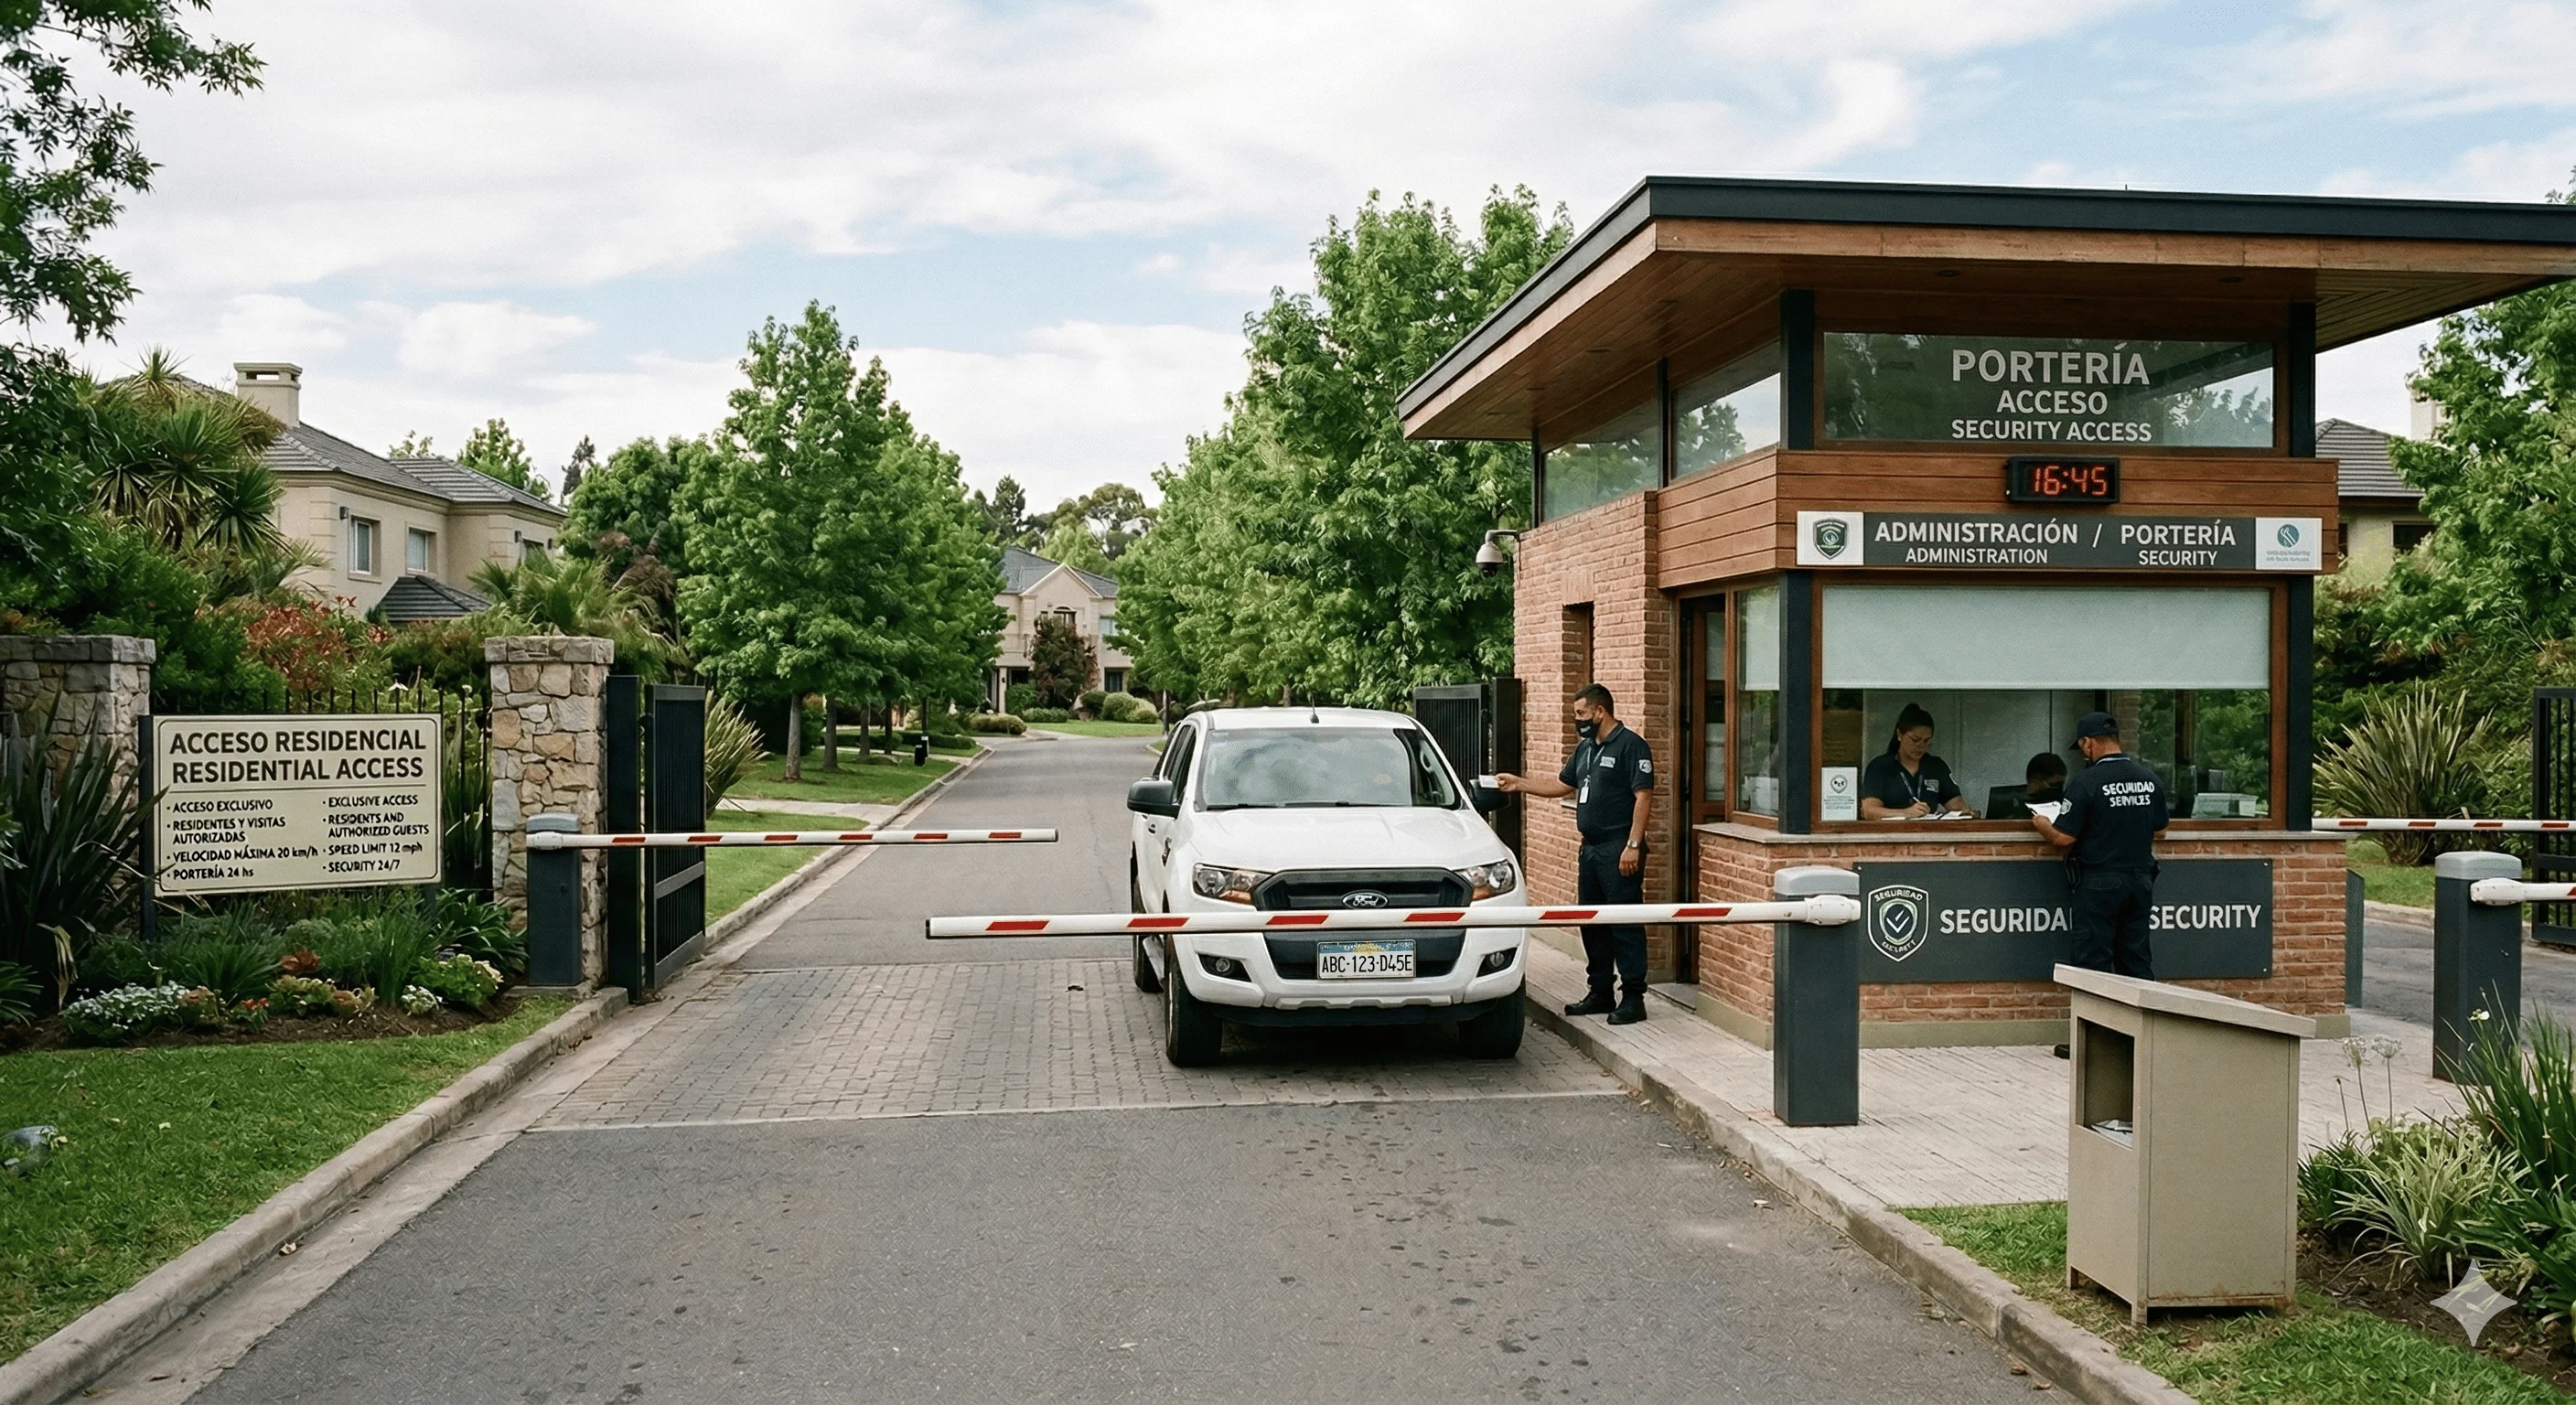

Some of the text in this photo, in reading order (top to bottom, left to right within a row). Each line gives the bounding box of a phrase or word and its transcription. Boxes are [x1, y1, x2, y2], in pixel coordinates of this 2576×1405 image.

[1951, 341, 2151, 385] PORTERÍA
[1996, 389, 2109, 415] ACCESO
[1951, 419, 2152, 442] SECURITY ACCESS
[2034, 465, 2107, 496] 16:45
[1874, 518, 2078, 544] ADMINISTRACIÓN
[2120, 519, 2237, 546] PORTERÍA
[1905, 547, 2048, 564] ADMINISTRATION
[2138, 550, 2218, 566] SECURITY
[169, 729, 426, 755] ACCESO RESIDENCIAL
[172, 756, 424, 784] RESIDENTIAL ACCESS
[172, 799, 274, 813] ACCESO EXCLUSIVO
[328, 795, 419, 808] EXCLUSIVE ACCESS
[172, 816, 286, 831] RESIDENTES Y VISITAS
[383, 812, 404, 823] AND
[172, 831, 246, 844] AUTORIZADAS
[328, 826, 391, 838] AUTHORIZED
[172, 850, 231, 863] VELOCIDAD
[278, 847, 290, 859] 20
[362, 843, 387, 854] LIMIT
[391, 842, 401, 853] 12
[173, 864, 254, 880] PORTERÍA 24 hs
[378, 859, 401, 872] 24/7
[1939, 905, 2262, 934] SEGURIDA SECURITY
